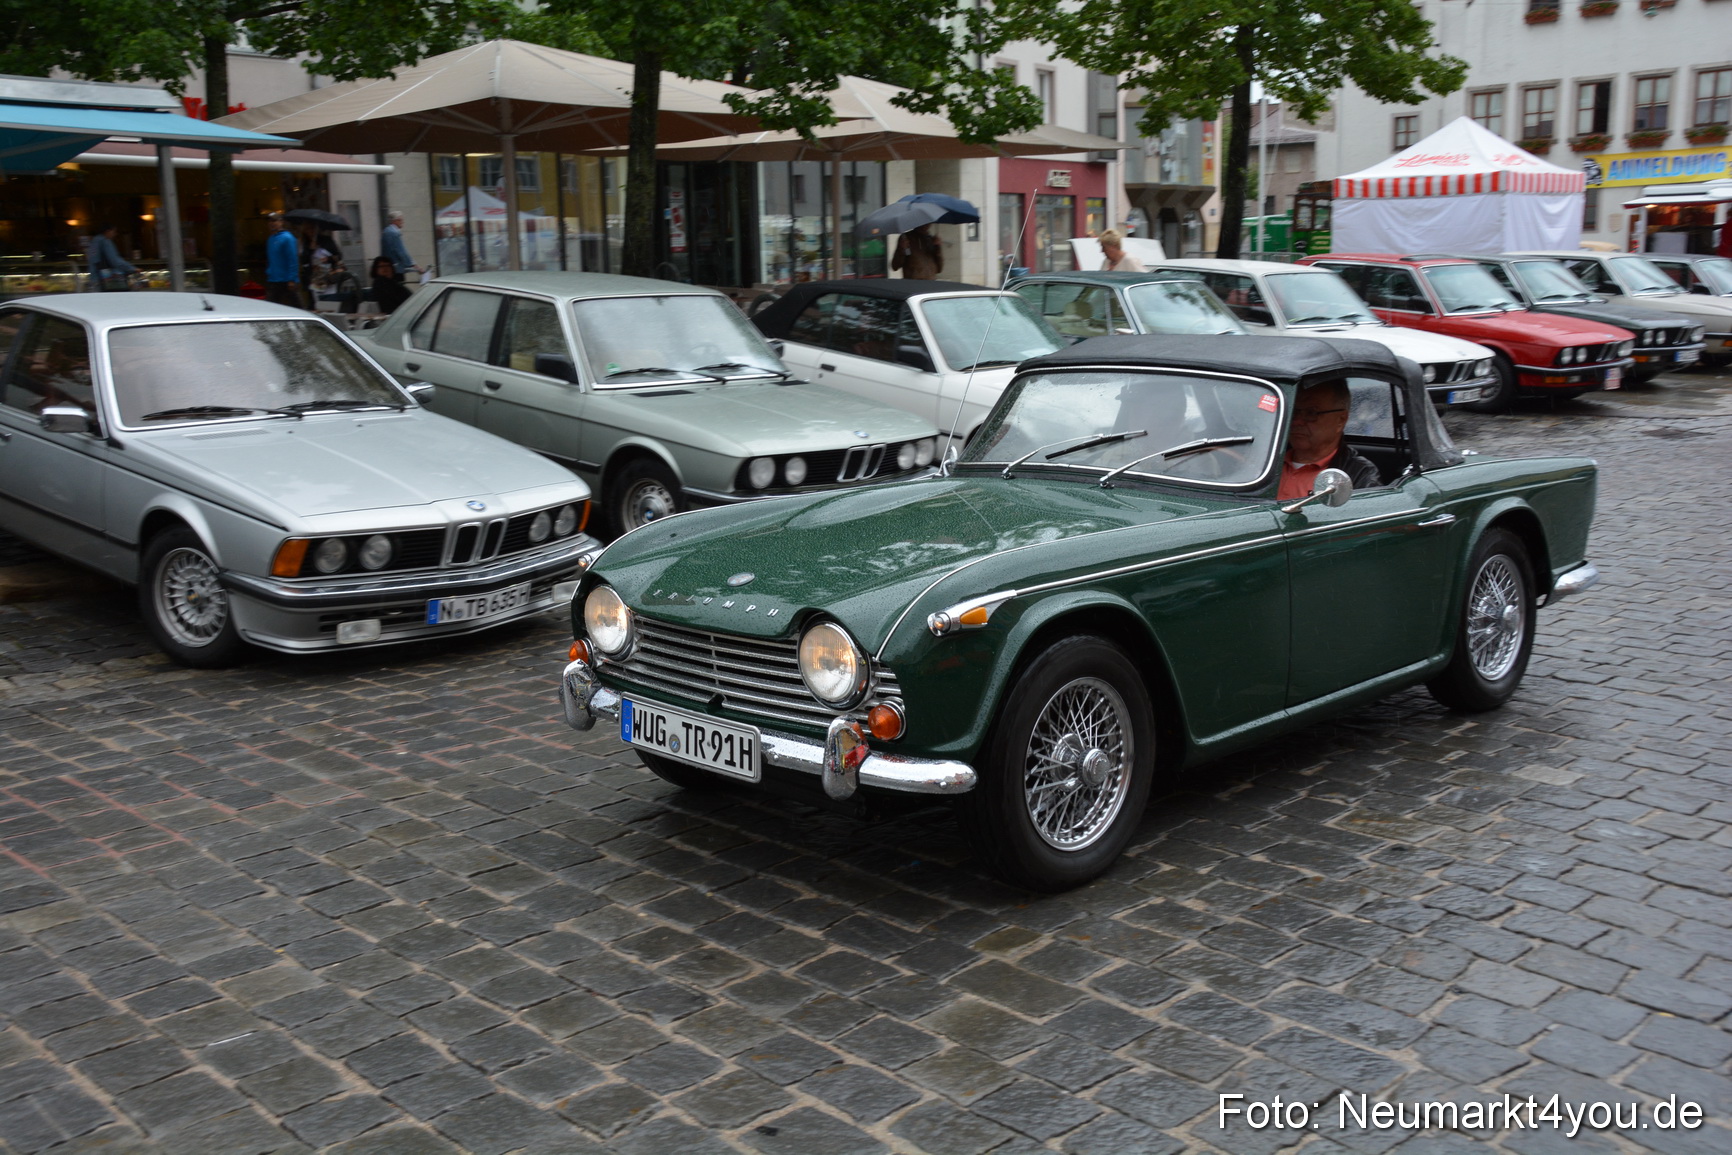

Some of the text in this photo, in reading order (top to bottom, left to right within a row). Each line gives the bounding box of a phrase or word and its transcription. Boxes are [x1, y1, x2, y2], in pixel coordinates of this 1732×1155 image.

[1606, 152, 1727, 181] ANMELDUNG
[441, 601, 454, 620] N
[653, 589, 779, 617] TRIUMPH
[633, 707, 667, 747] WUG
